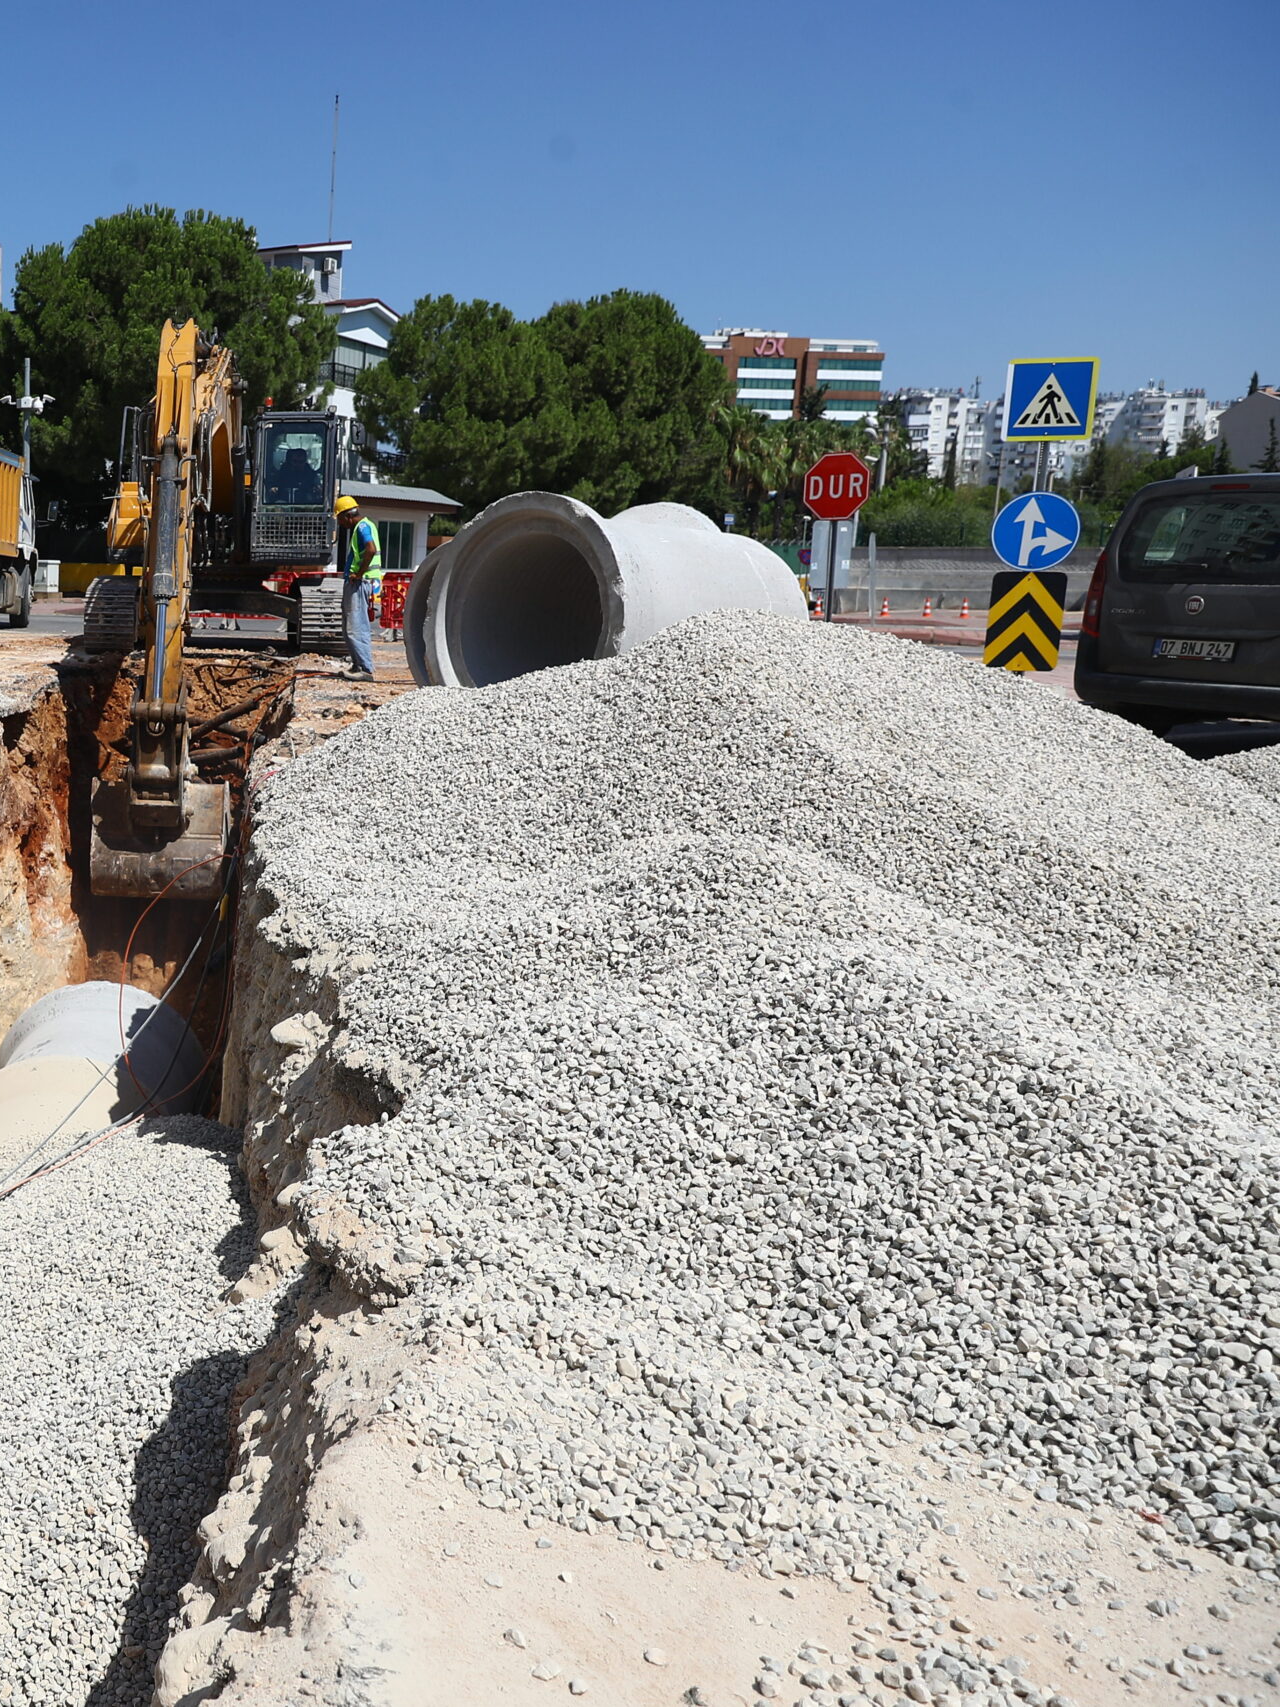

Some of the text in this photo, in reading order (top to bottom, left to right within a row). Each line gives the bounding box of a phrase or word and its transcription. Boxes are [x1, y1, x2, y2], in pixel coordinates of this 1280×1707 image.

[808, 472, 865, 501] DUR
[1160, 640, 1231, 657] 07 BNJ 247
